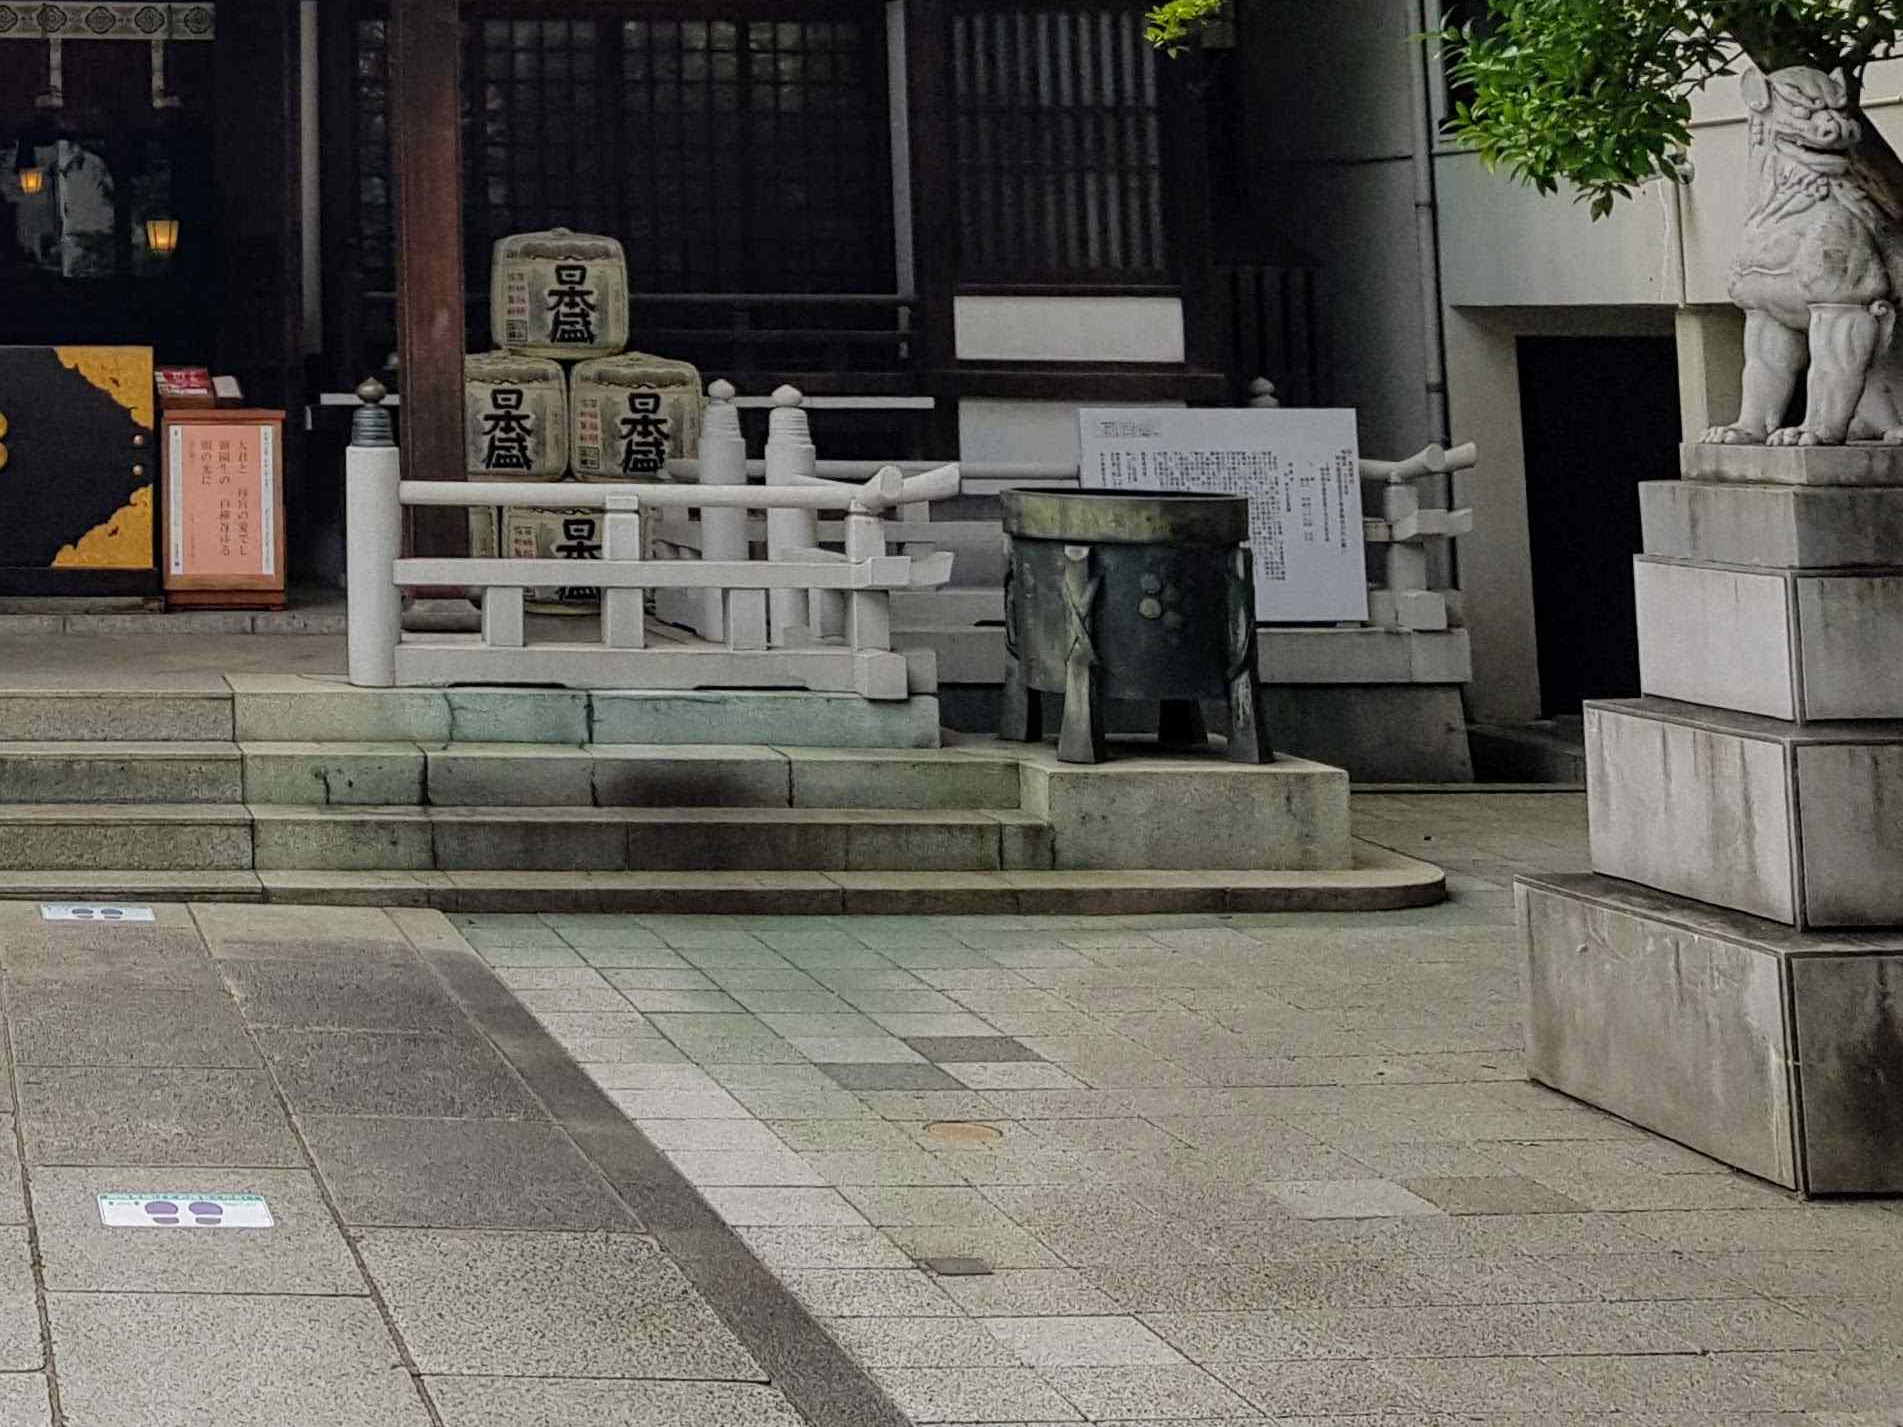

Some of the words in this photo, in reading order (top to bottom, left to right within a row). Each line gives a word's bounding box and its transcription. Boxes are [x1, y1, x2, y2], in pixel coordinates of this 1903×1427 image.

[546, 264, 597, 345] 日本盛
[482, 388, 533, 471] 日本盛
[619, 392, 671, 474] 日本盛
